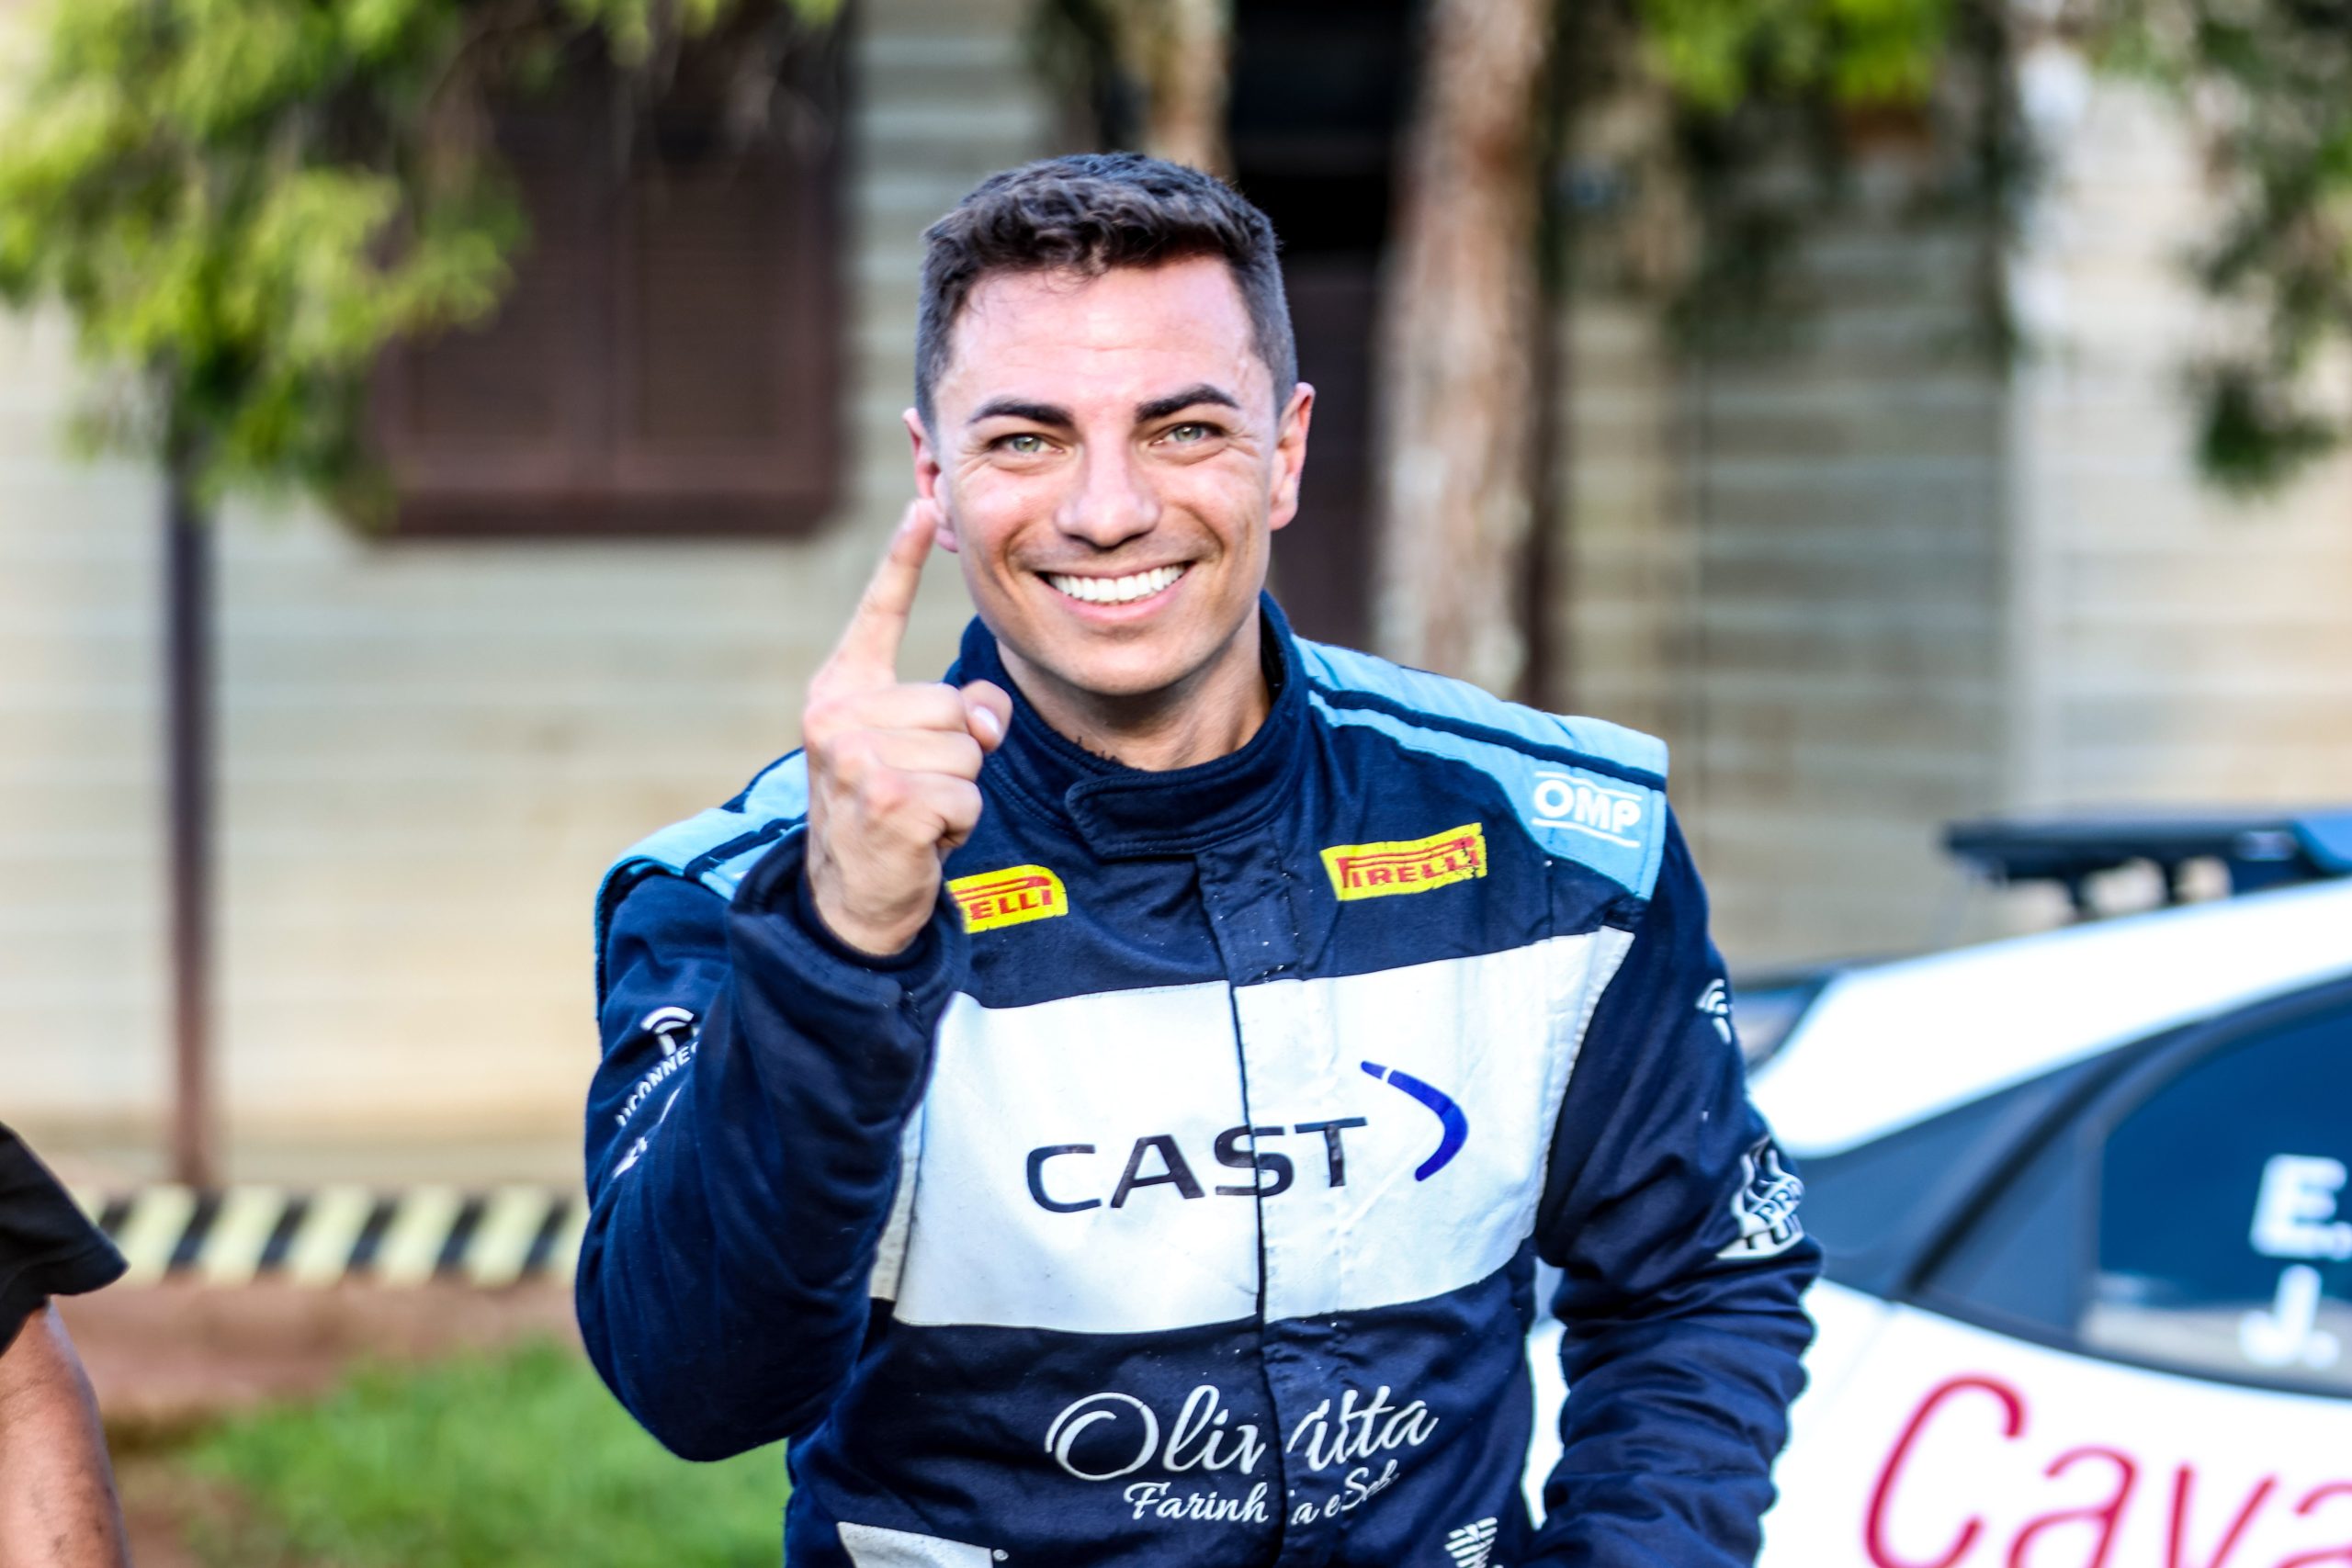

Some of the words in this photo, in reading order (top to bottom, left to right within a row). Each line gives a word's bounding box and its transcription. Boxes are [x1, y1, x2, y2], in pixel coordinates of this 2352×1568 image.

[1532, 779, 1643, 829] OMP
[1336, 835, 1481, 889] PIRELLI
[952, 875, 1053, 920] ELLI
[1025, 1116, 1369, 1214] CAST
